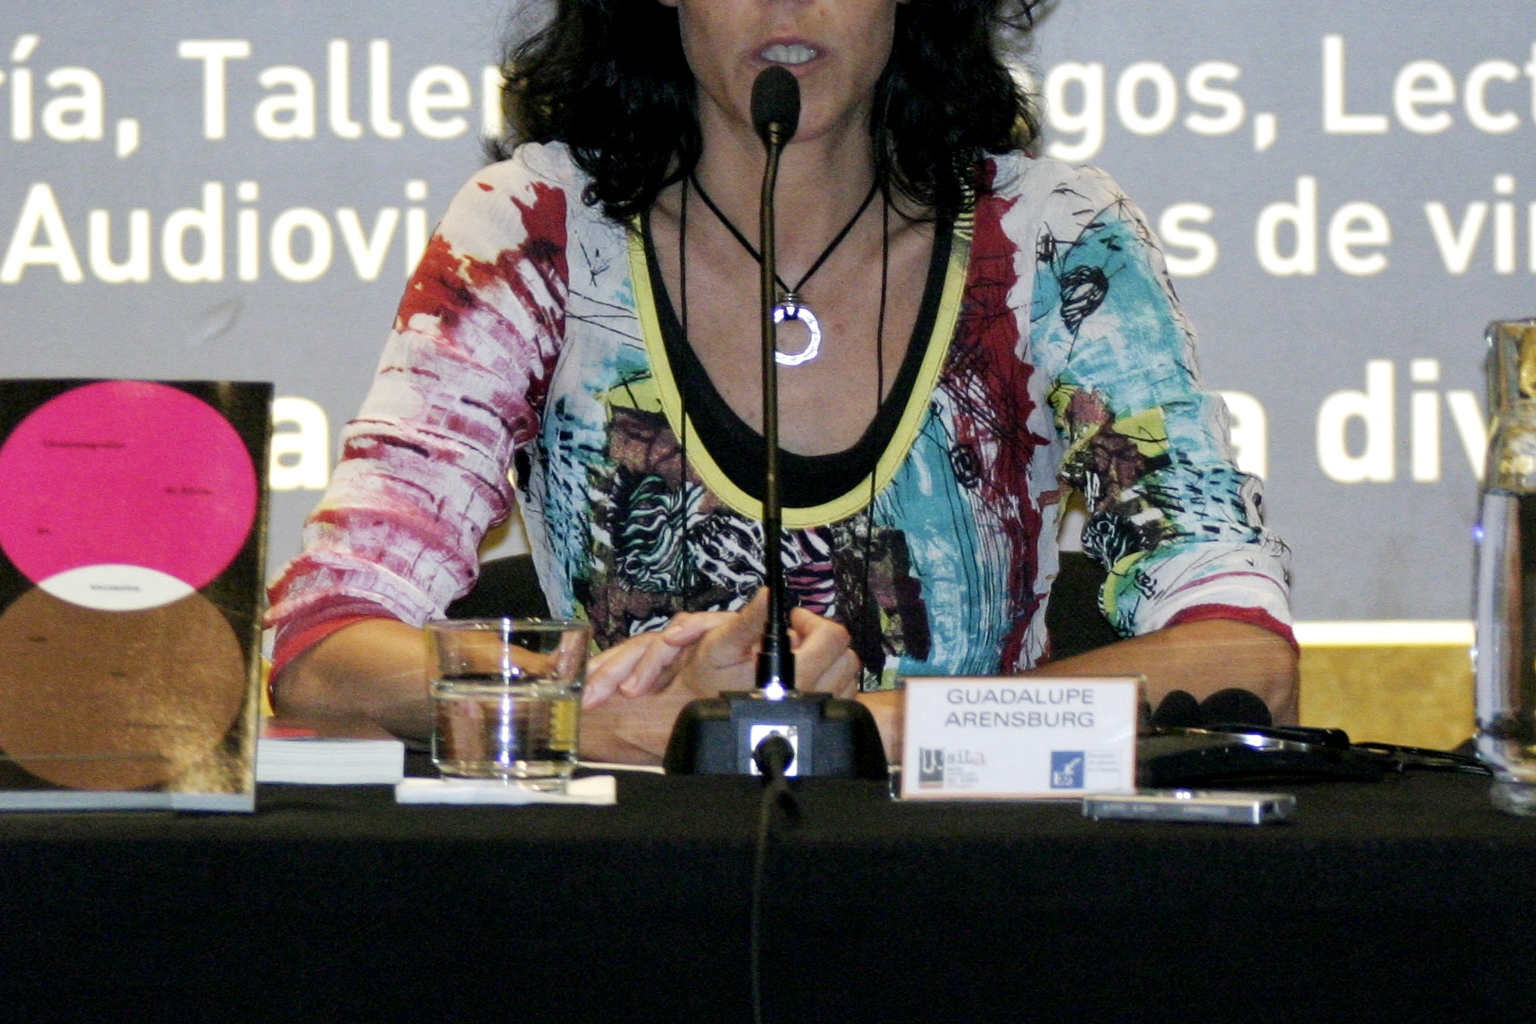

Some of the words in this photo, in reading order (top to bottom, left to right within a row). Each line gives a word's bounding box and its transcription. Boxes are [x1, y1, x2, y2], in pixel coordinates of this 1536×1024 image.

[0, 34, 139, 158] ía,
[0, 182, 427, 282] Audiovi
[1255, 176, 1391, 275] de
[944, 711, 1095, 727] ARENSBURG
[946, 688, 1095, 705] GUADALUPE
